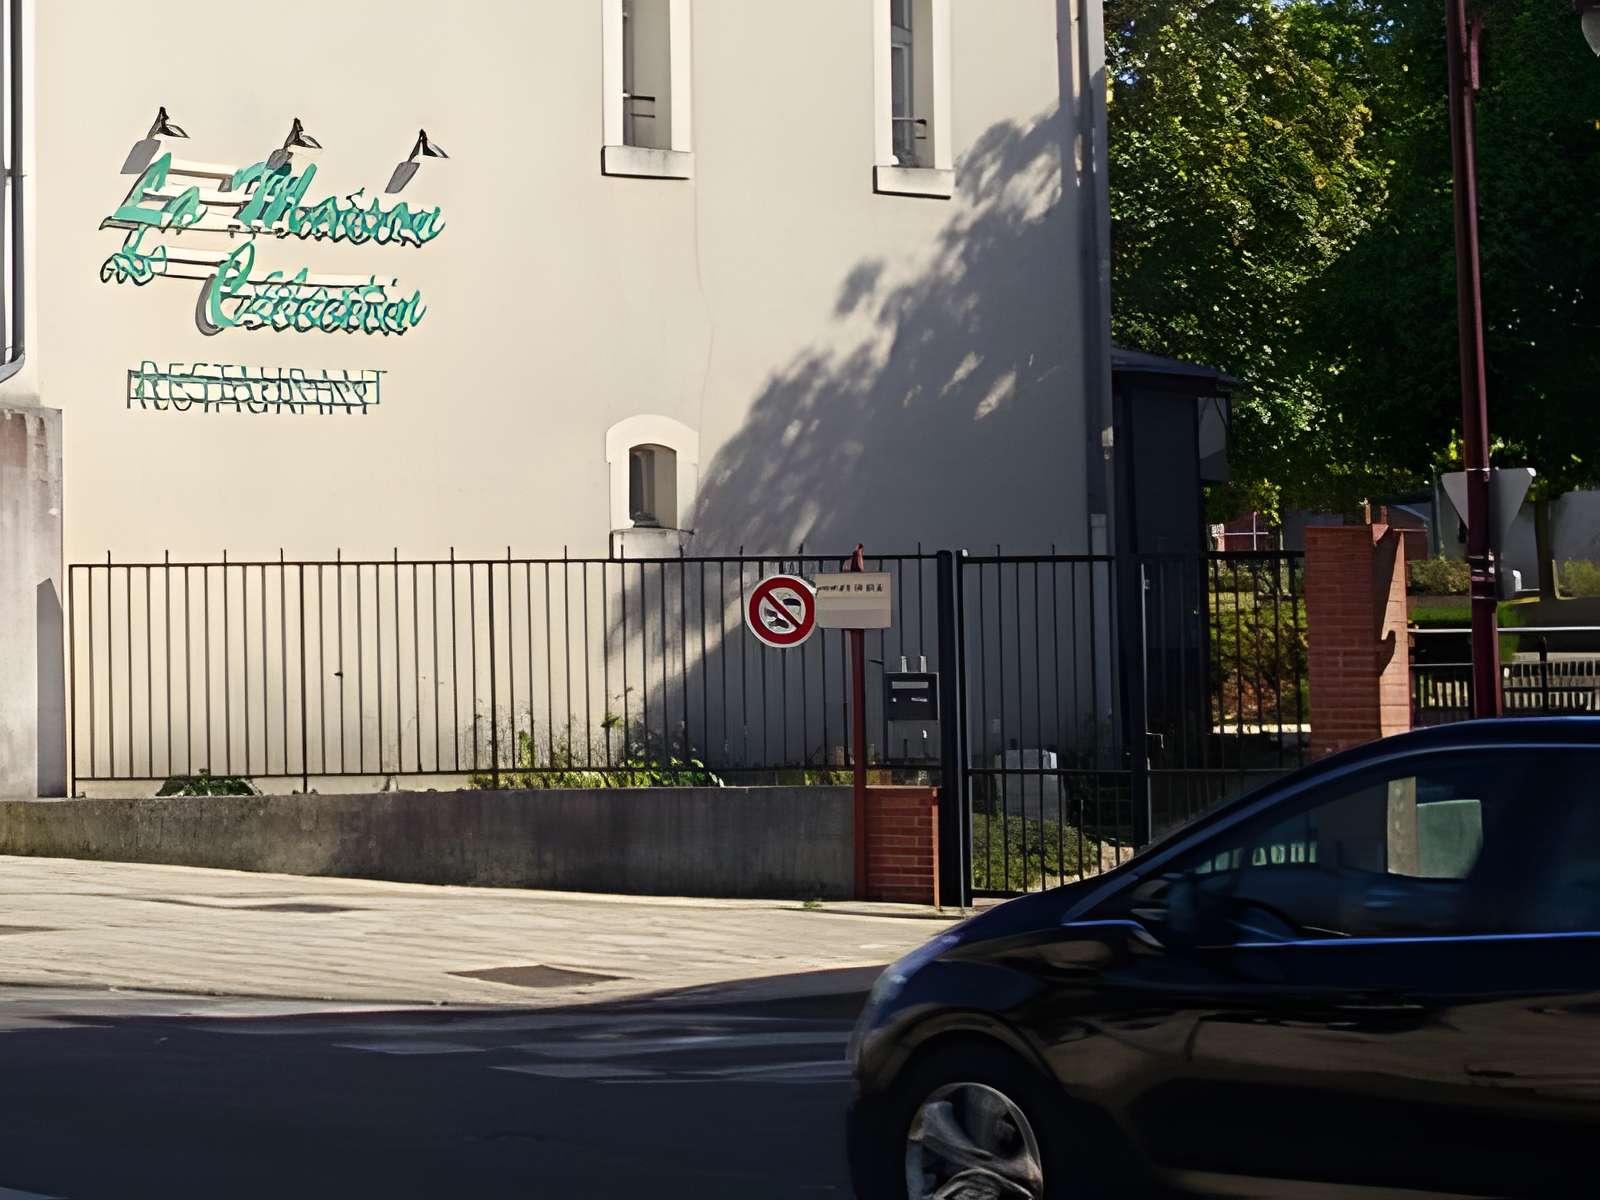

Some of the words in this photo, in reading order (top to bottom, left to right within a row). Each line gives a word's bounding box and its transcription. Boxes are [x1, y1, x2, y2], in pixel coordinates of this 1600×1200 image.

[111, 152, 203, 228] La
[232, 161, 444, 244] Maison
[130, 361, 386, 410] RESTAURANT
